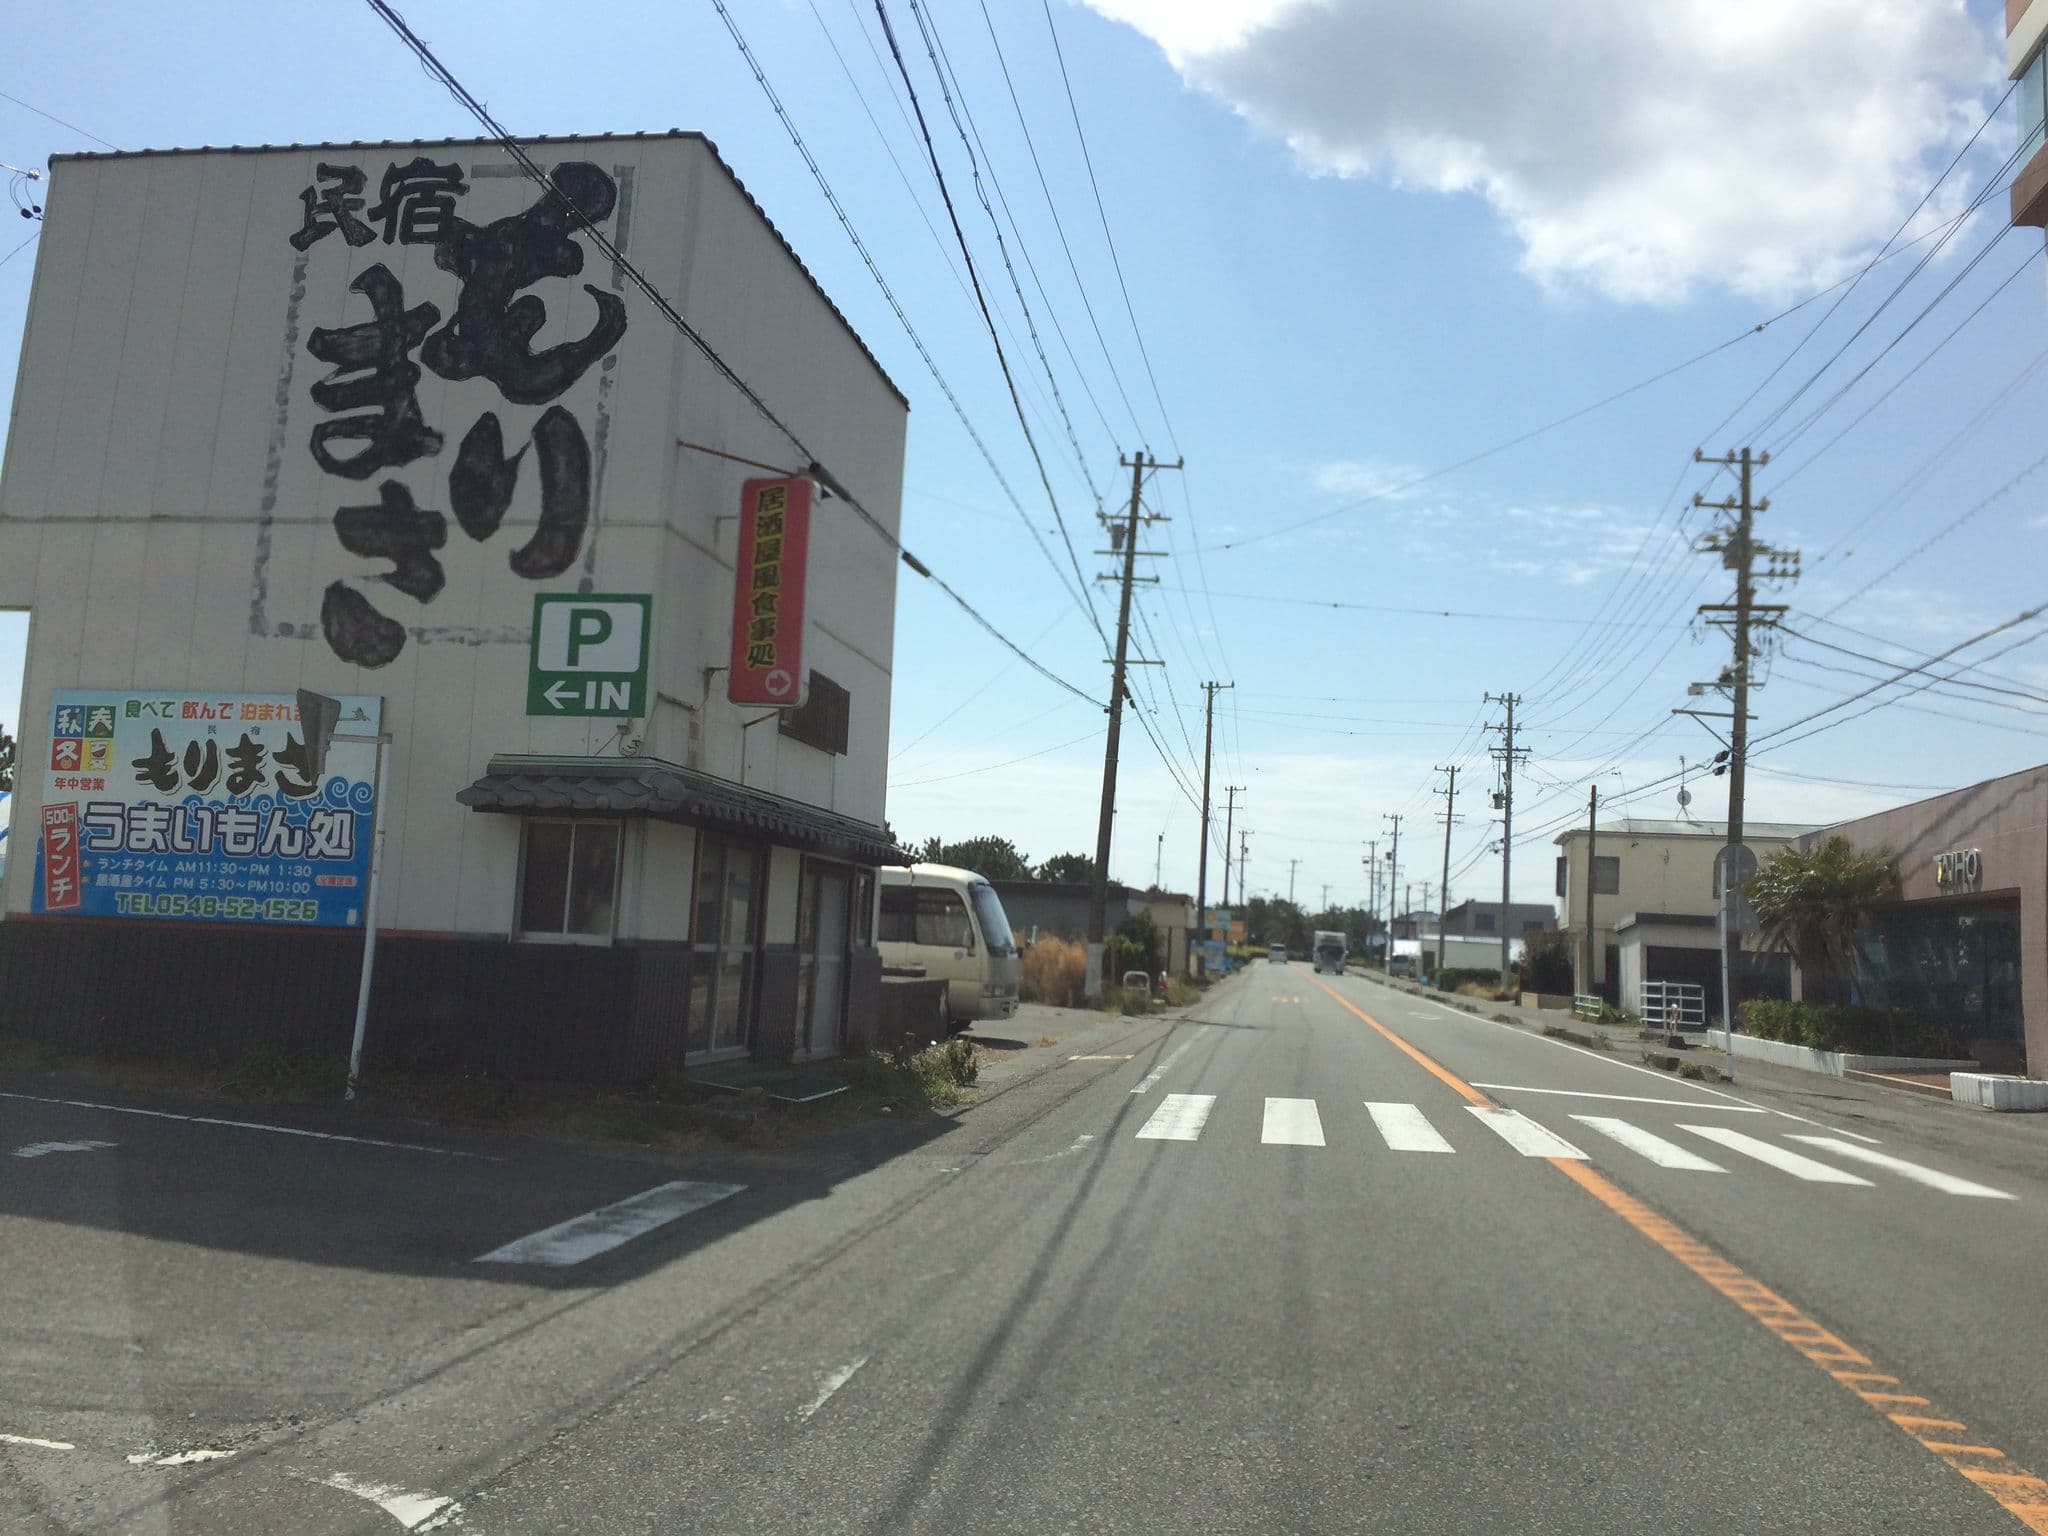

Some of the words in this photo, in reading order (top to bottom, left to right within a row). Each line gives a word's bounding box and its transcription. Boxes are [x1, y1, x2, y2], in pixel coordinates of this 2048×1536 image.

[290, 157, 470, 251] 民宿
[567, 608, 613, 667] P
[124, 701, 175, 719] 食べて
[181, 702, 234, 721] 飲んで
[584, 681, 631, 711] IN
[54, 777, 105, 792] 年中営業
[131, 727, 320, 800] もりまさ
[84, 801, 355, 860] うまいもん処
[48, 827, 74, 902] ランチ
[97, 858, 169, 872] ランチタイム
